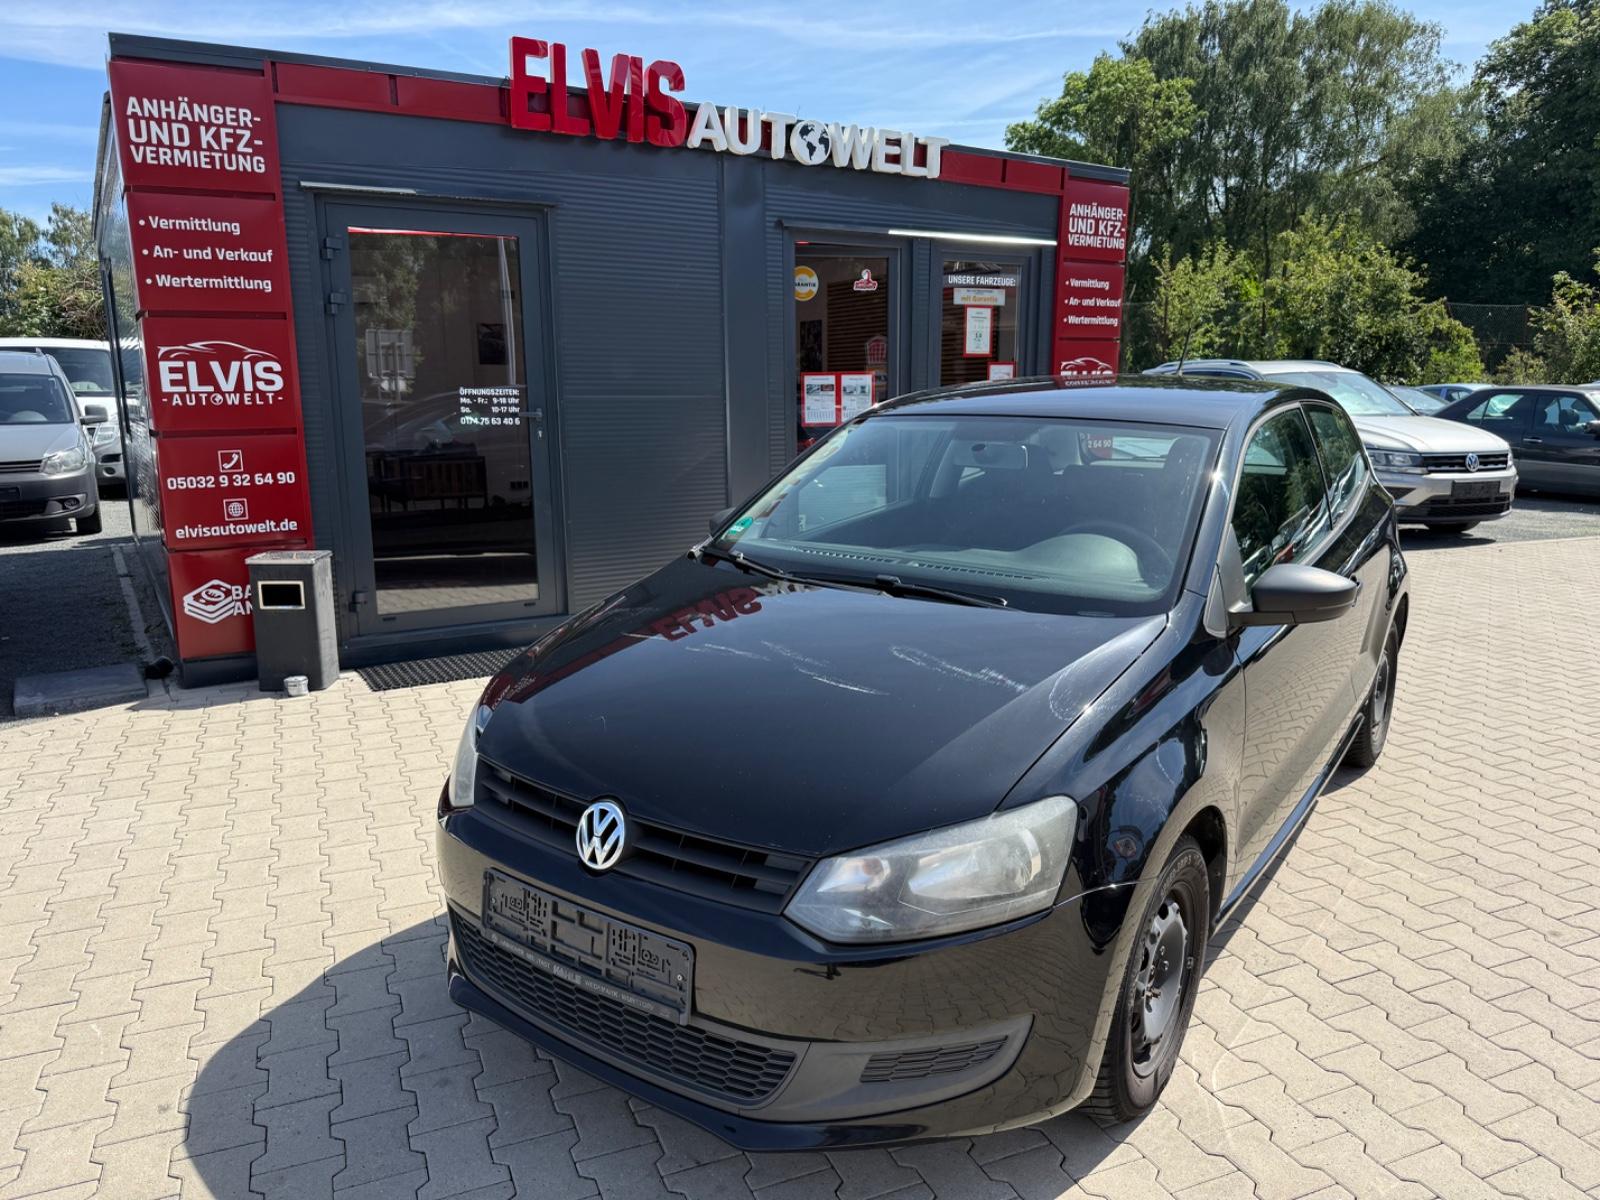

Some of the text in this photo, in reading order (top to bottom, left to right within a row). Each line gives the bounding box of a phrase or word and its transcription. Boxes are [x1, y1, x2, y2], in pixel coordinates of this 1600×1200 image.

[126, 96, 261, 128] ANHÄNGER-
[509, 36, 950, 179] ELVIS AUTOWELT
[128, 119, 263, 153] UND KFZ-
[130, 145, 266, 173] VERMIETUNG
[1069, 202, 1127, 221] ANHÄNGER-
[149, 215, 241, 235] Vermittlung
[1069, 217, 1126, 237] UND KFZ-
[1068, 233, 1125, 250] VERMIETUNG
[153, 245, 273, 263] An- und Verkauf
[156, 274, 272, 293] Wertermittlung
[948, 274, 1016, 287] UNSERE FAHRZEUGE:
[1070, 278, 1110, 291] Vermittlung
[1069, 296, 1122, 308] An- und Verkauf
[1068, 315, 1119, 327] Wertermittlung
[158, 360, 284, 393] ELVIS
[459, 386, 520, 396] ÖFFNUNGSZEITEN:
[166, 471, 296, 490] 05032 9 32 64 90
[175, 518, 298, 539] elvisautowelt.de
